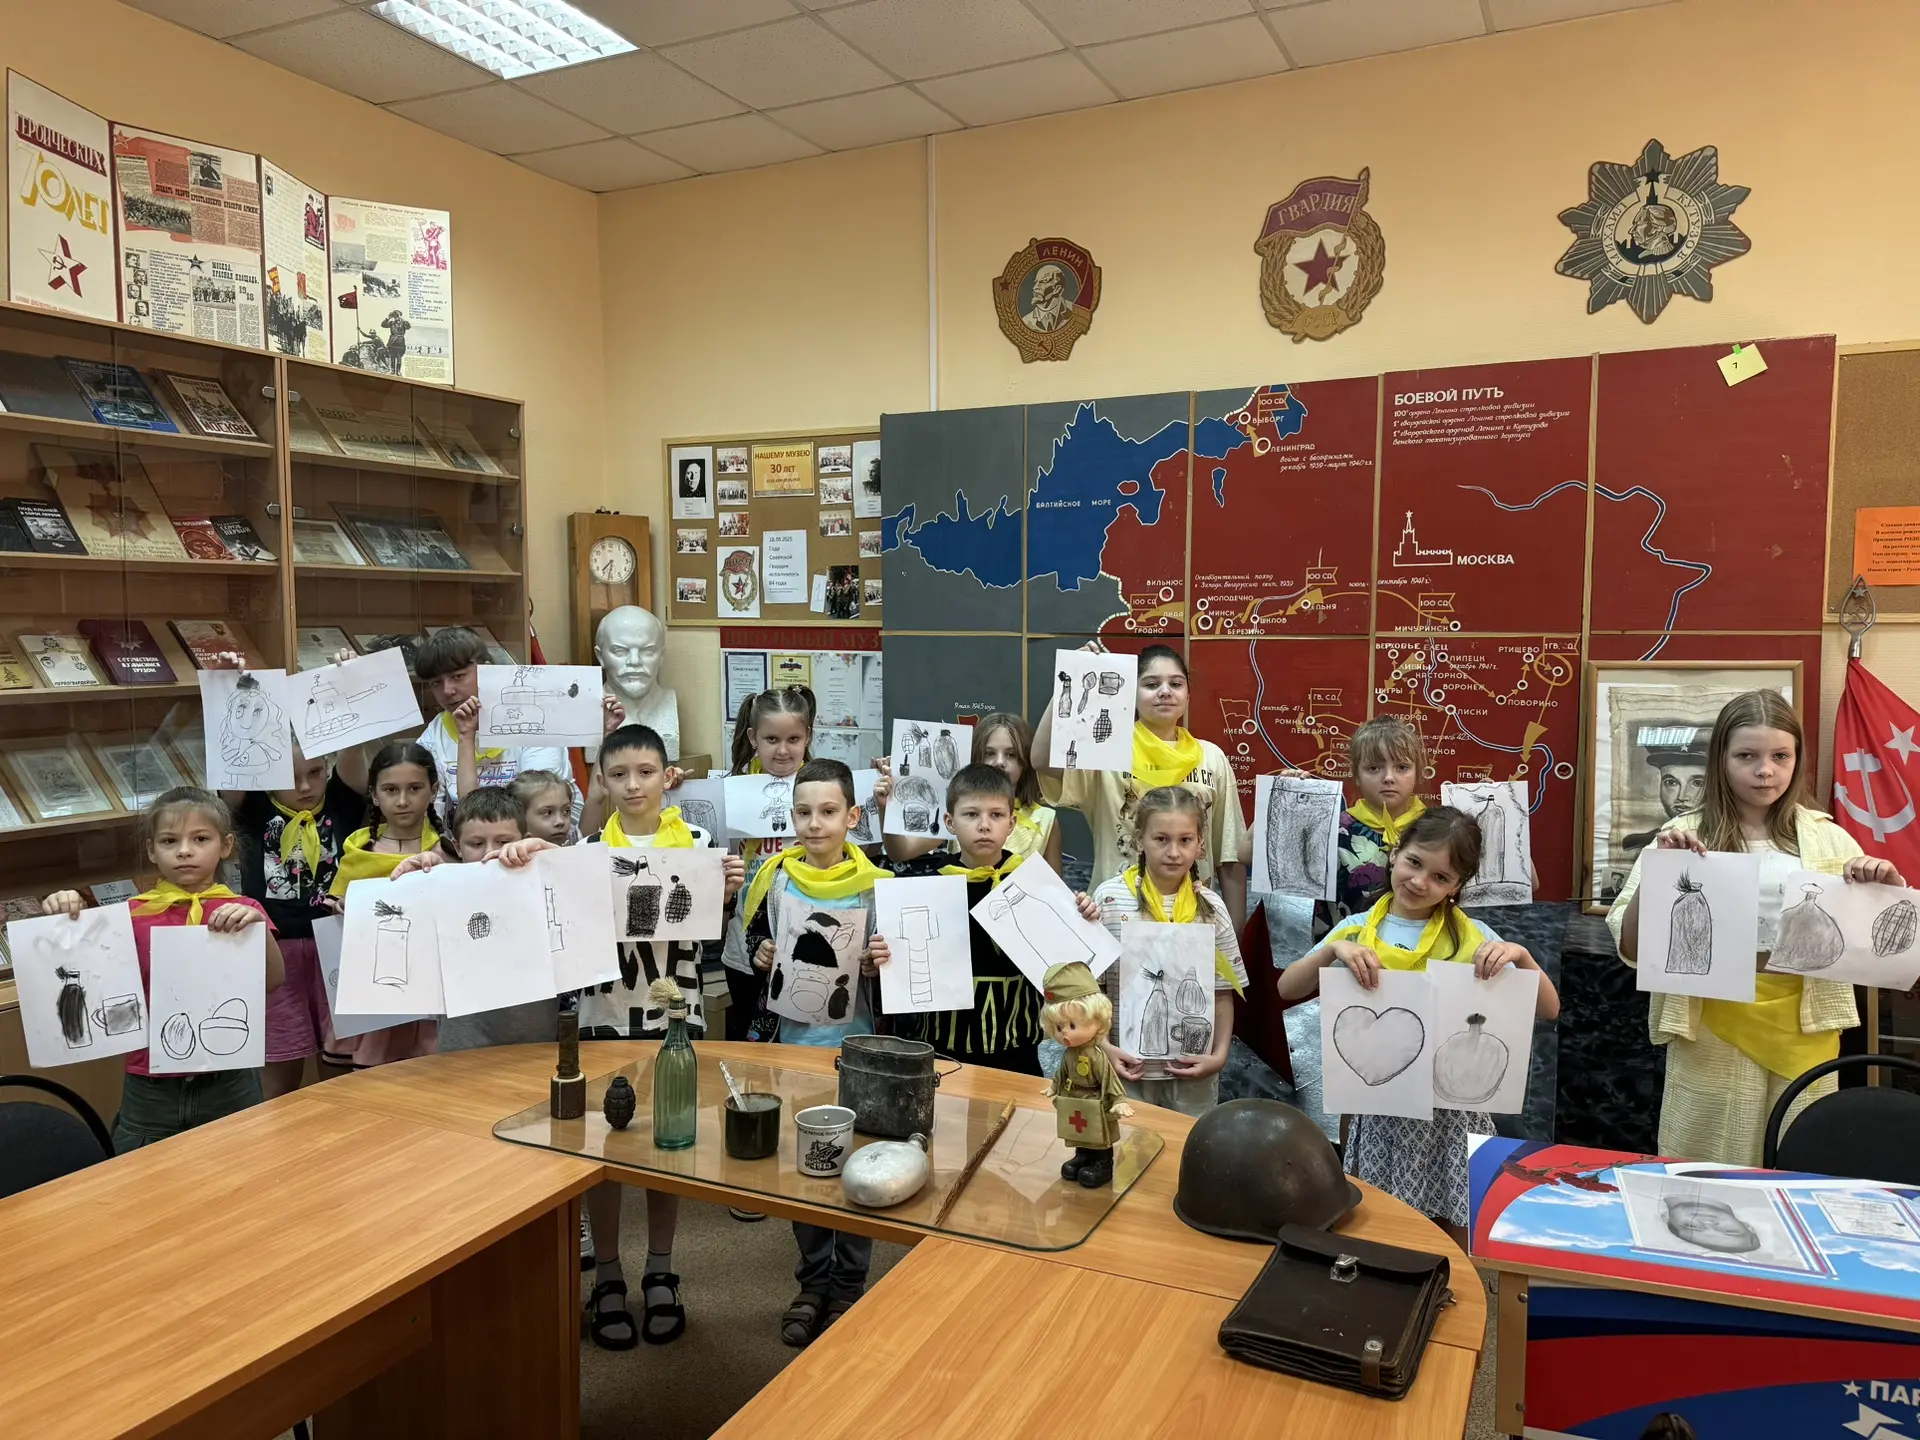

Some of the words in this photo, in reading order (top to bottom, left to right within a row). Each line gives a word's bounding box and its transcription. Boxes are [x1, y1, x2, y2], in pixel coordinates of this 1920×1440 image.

[15, 112, 105, 174] ГЕРОИЧЕСКИХ
[65, 187, 109, 235] ЛЕТ
[1278, 193, 1355, 226] ГВАРДИЯ
[1677, 193, 1700, 260] КУТУЗОВ
[1604, 202, 1628, 266] МИХАИЛ
[1043, 246, 1083, 267] ЛЕНИН
[1394, 388, 1458, 406] БОЕВОЙ
[1462, 386, 1505, 401] ПУТЬ
[1459, 404, 1501, 415] стрелковой
[1252, 415, 1285, 424] ВЫБОРГ
[1495, 411, 1537, 422] стрелковой
[203, 421, 252, 435] МОСКВУ
[1271, 443, 1316, 452] ЛЕНИНГРАД
[755, 451, 787, 460] НАШЕМУ
[787, 449, 811, 459] МУЗЕЮ
[770, 463, 782, 474] 30
[783, 465, 795, 473] ЛЕТ
[1036, 500, 1081, 508] БАЛТИЙСКОЕ
[1457, 554, 1515, 566] МОСКВА
[1437, 599, 1449, 607] СД
[725, 629, 835, 648] ШКОЛЬНЫЙ
[841, 632, 880, 649] МУЗ
[1443, 683, 1485, 691] ВОРОНЕЖ
[1508, 699, 1558, 708] ПОВОРИНО
[1458, 708, 1488, 716] ЛИСКИ
[1321, 770, 1354, 778] ПОЛТАВ
